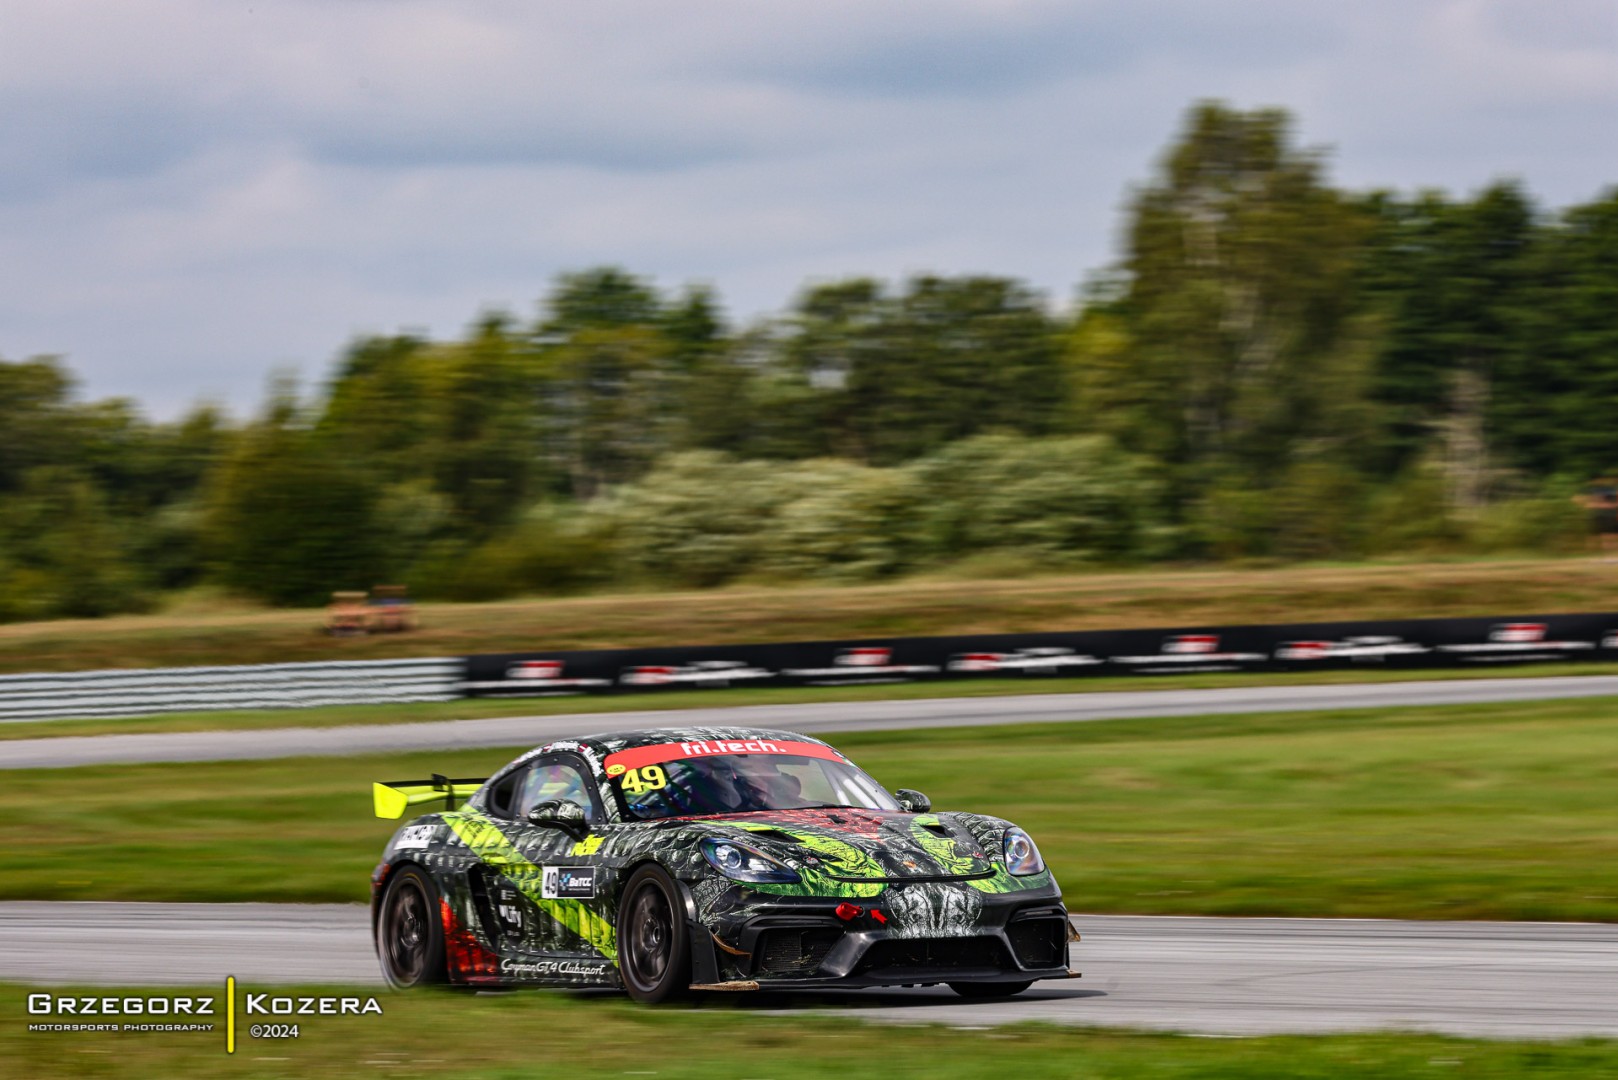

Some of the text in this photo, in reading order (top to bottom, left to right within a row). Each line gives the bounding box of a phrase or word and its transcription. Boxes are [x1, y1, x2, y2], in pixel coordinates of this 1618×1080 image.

[621, 765, 667, 793] 49
[545, 872, 557, 895] 49
[569, 877, 593, 887] BaTCC
[501, 959, 606, 977] Cayman GT4 Clubsport
